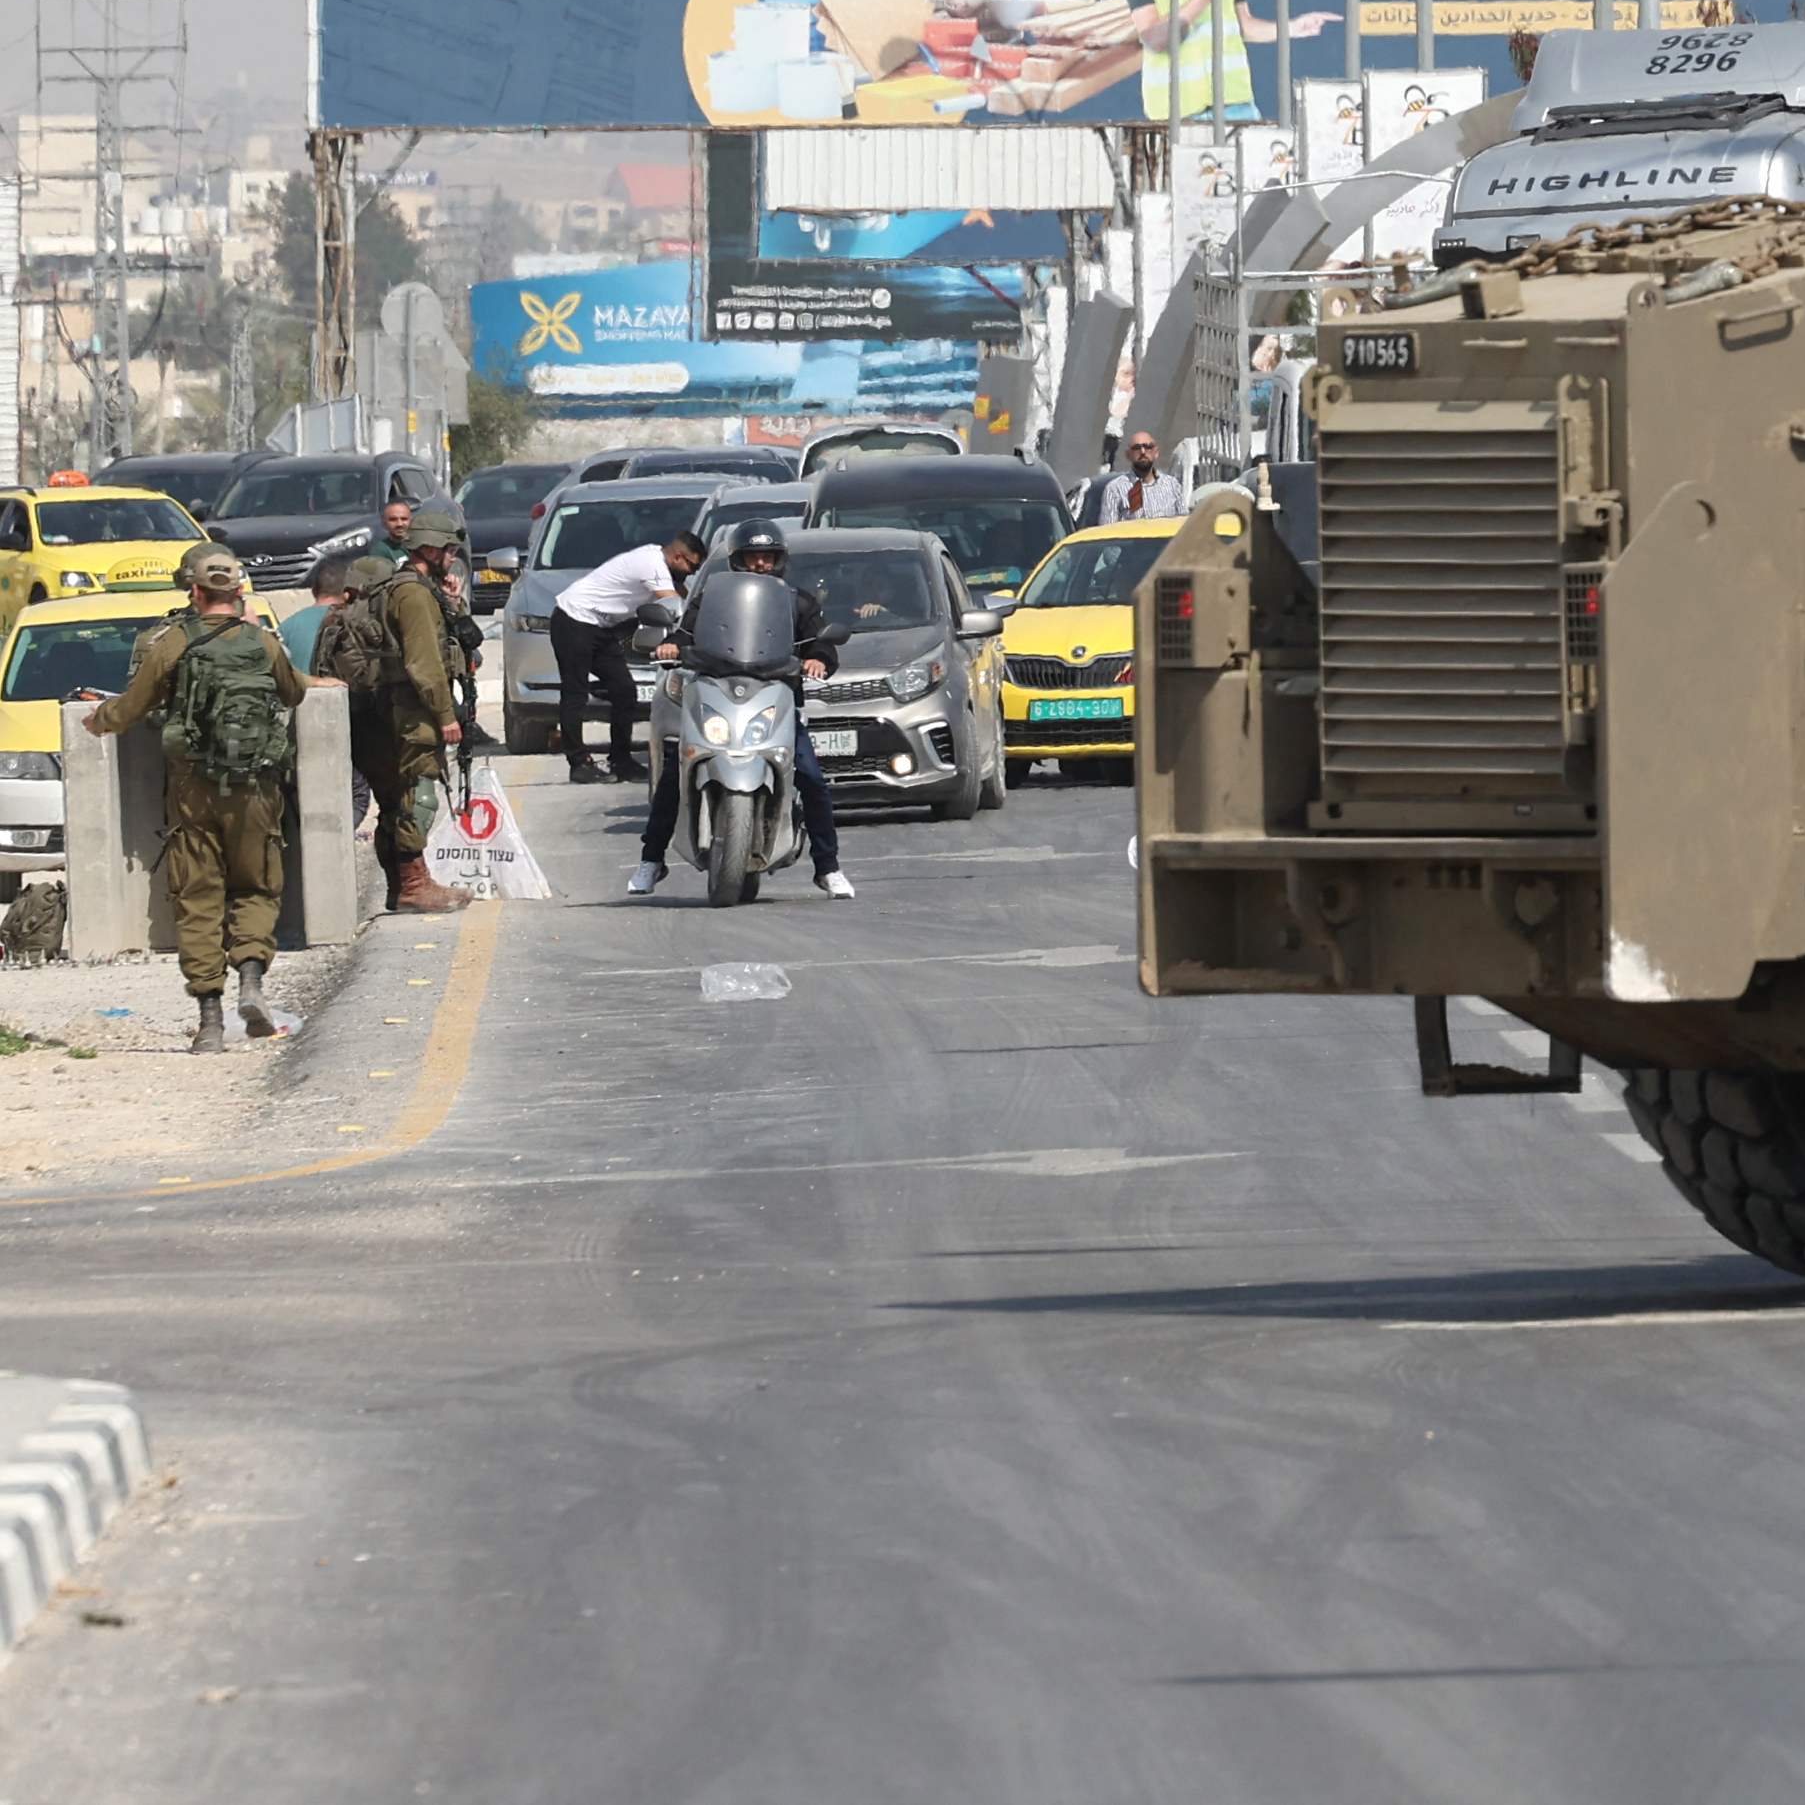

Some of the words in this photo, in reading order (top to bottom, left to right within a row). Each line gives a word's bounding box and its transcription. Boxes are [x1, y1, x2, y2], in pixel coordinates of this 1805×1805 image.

[1645, 50, 1740, 76] 8296
[1487, 166, 1739, 196] HIGHLINE
[1344, 337, 1409, 368] 910565
[115, 568, 144, 580] taxi
[436, 848, 480, 860] מחסום
[486, 849, 515, 863] עצור
